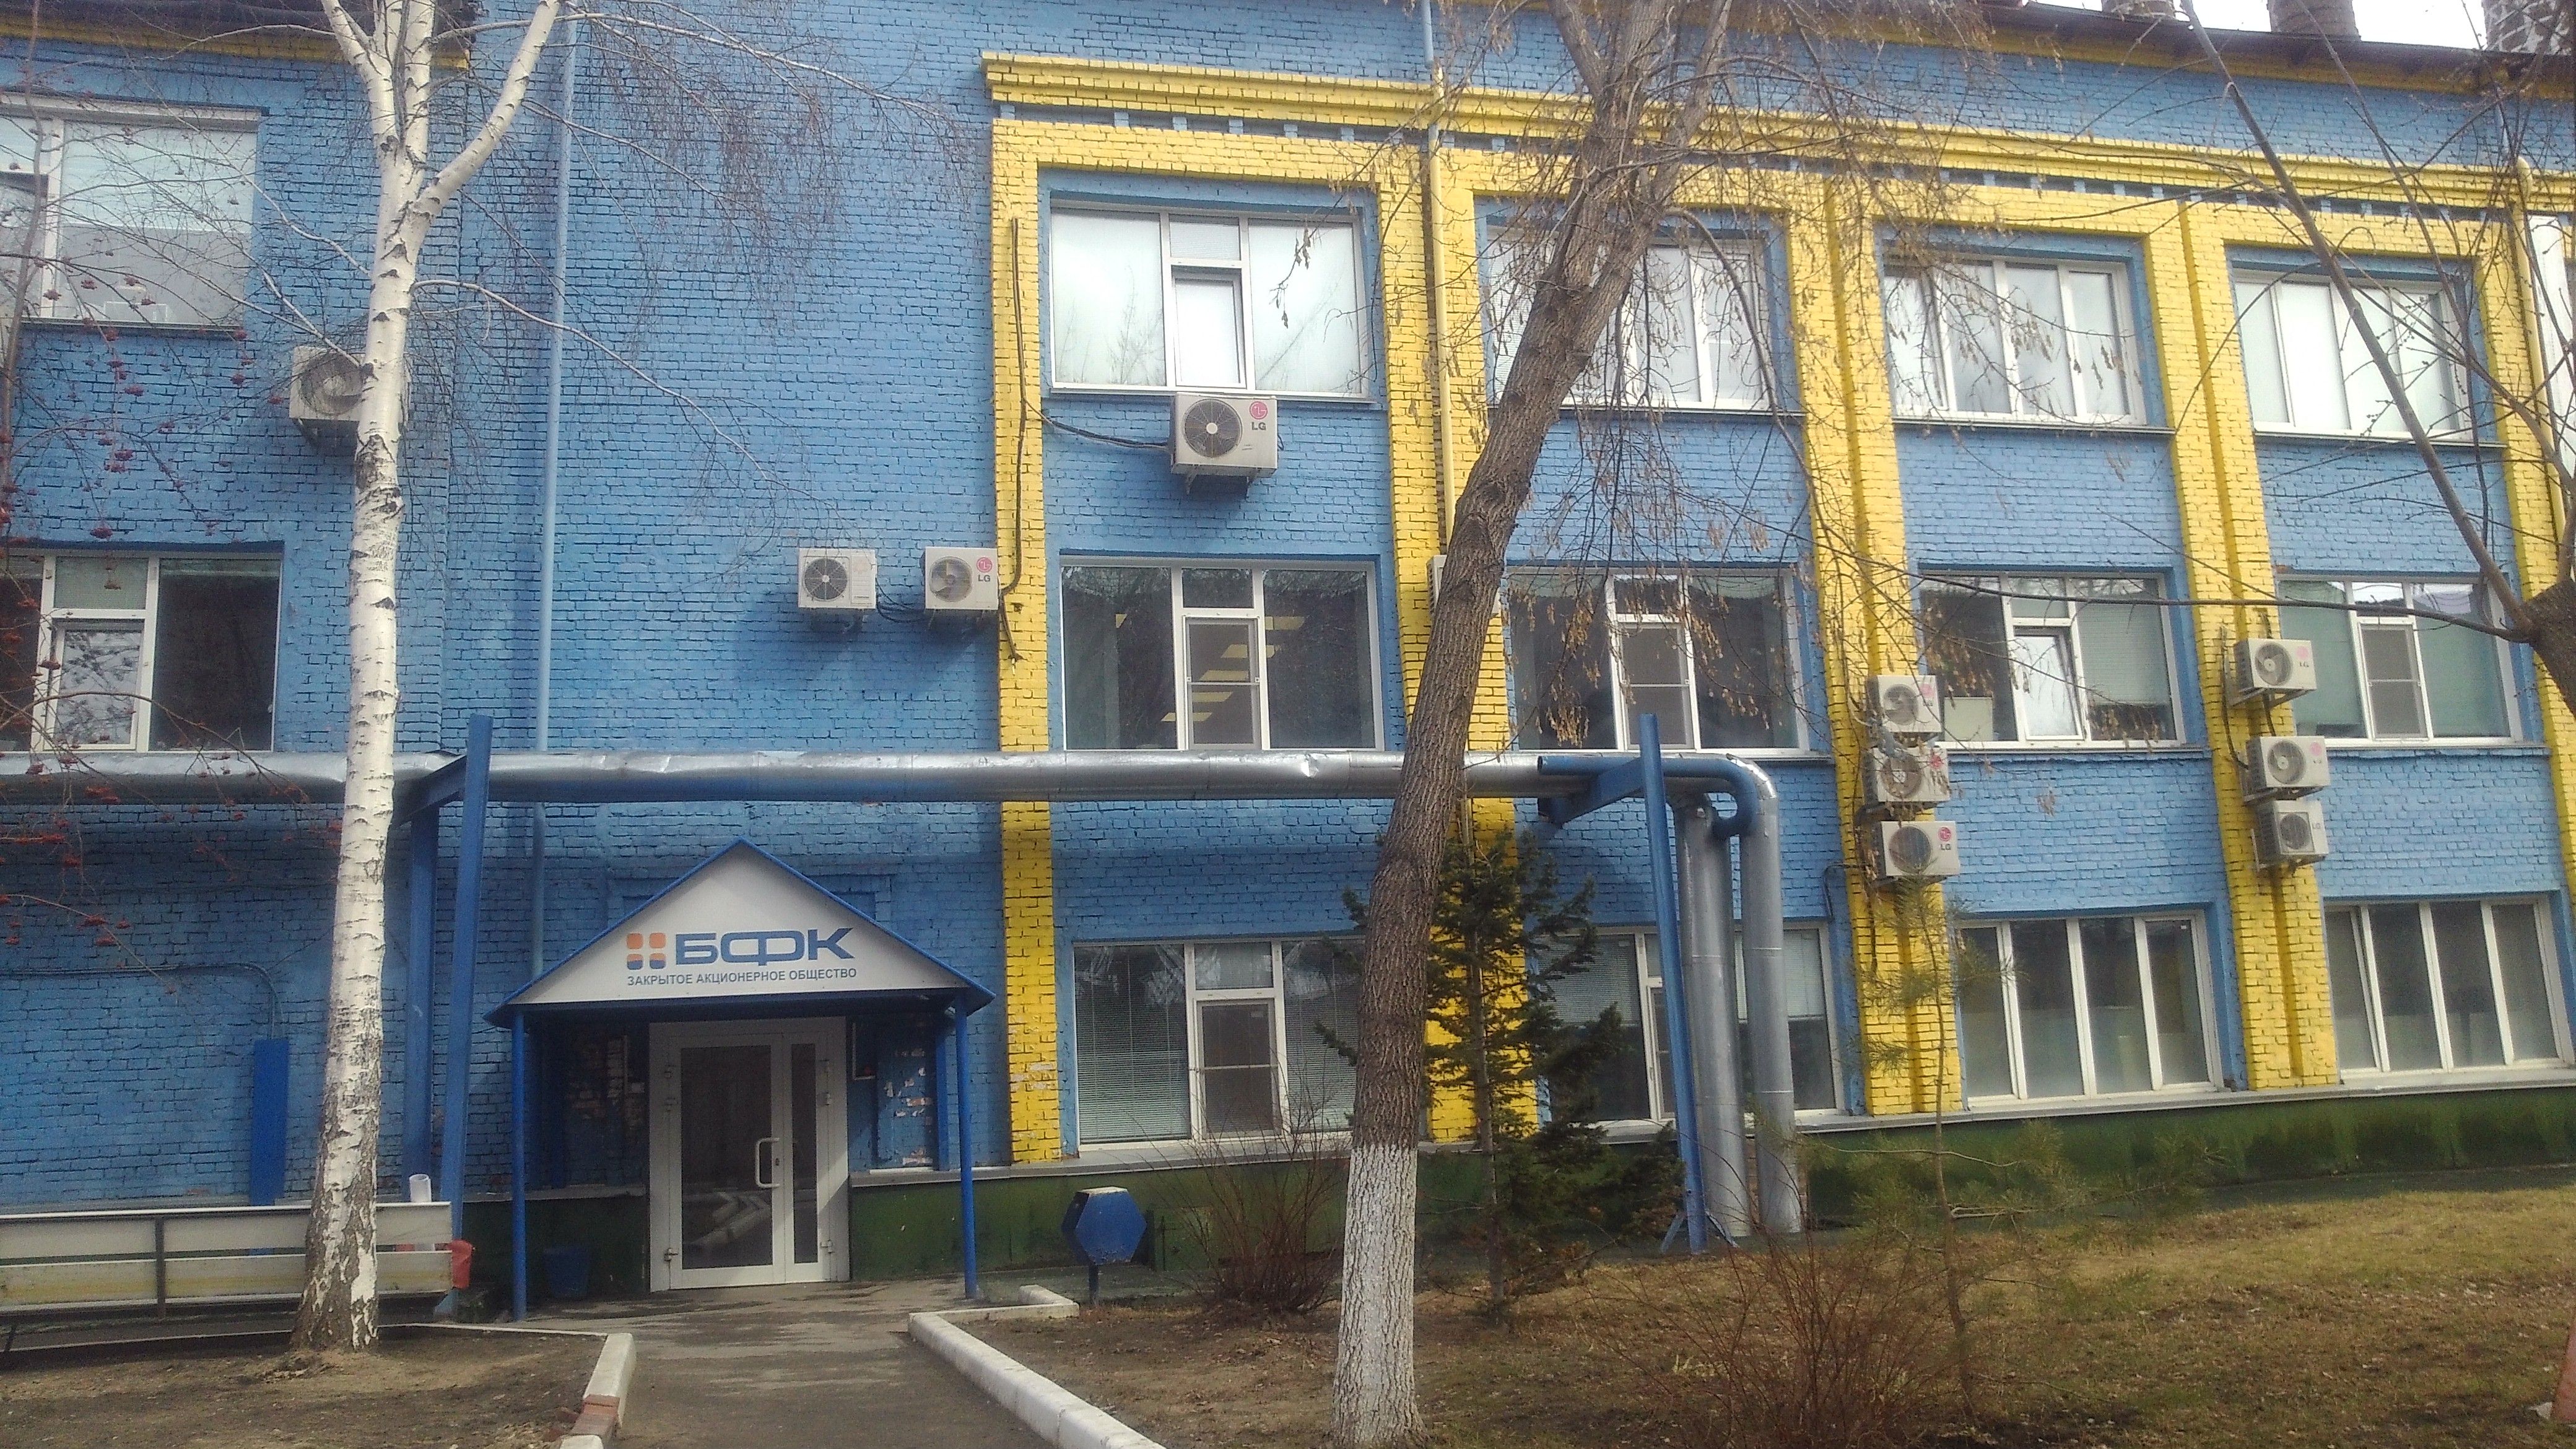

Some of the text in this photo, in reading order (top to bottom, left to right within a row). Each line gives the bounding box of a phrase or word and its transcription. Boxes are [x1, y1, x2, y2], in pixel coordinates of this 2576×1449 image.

[1251, 422, 1266, 431] LG
[978, 574, 991, 582] LG
[675, 928, 855, 966] БФК
[627, 967, 857, 986] ЗАКРЫТОЕ АКЦИОНЕРНОЕ ОБЩЕСТВО
